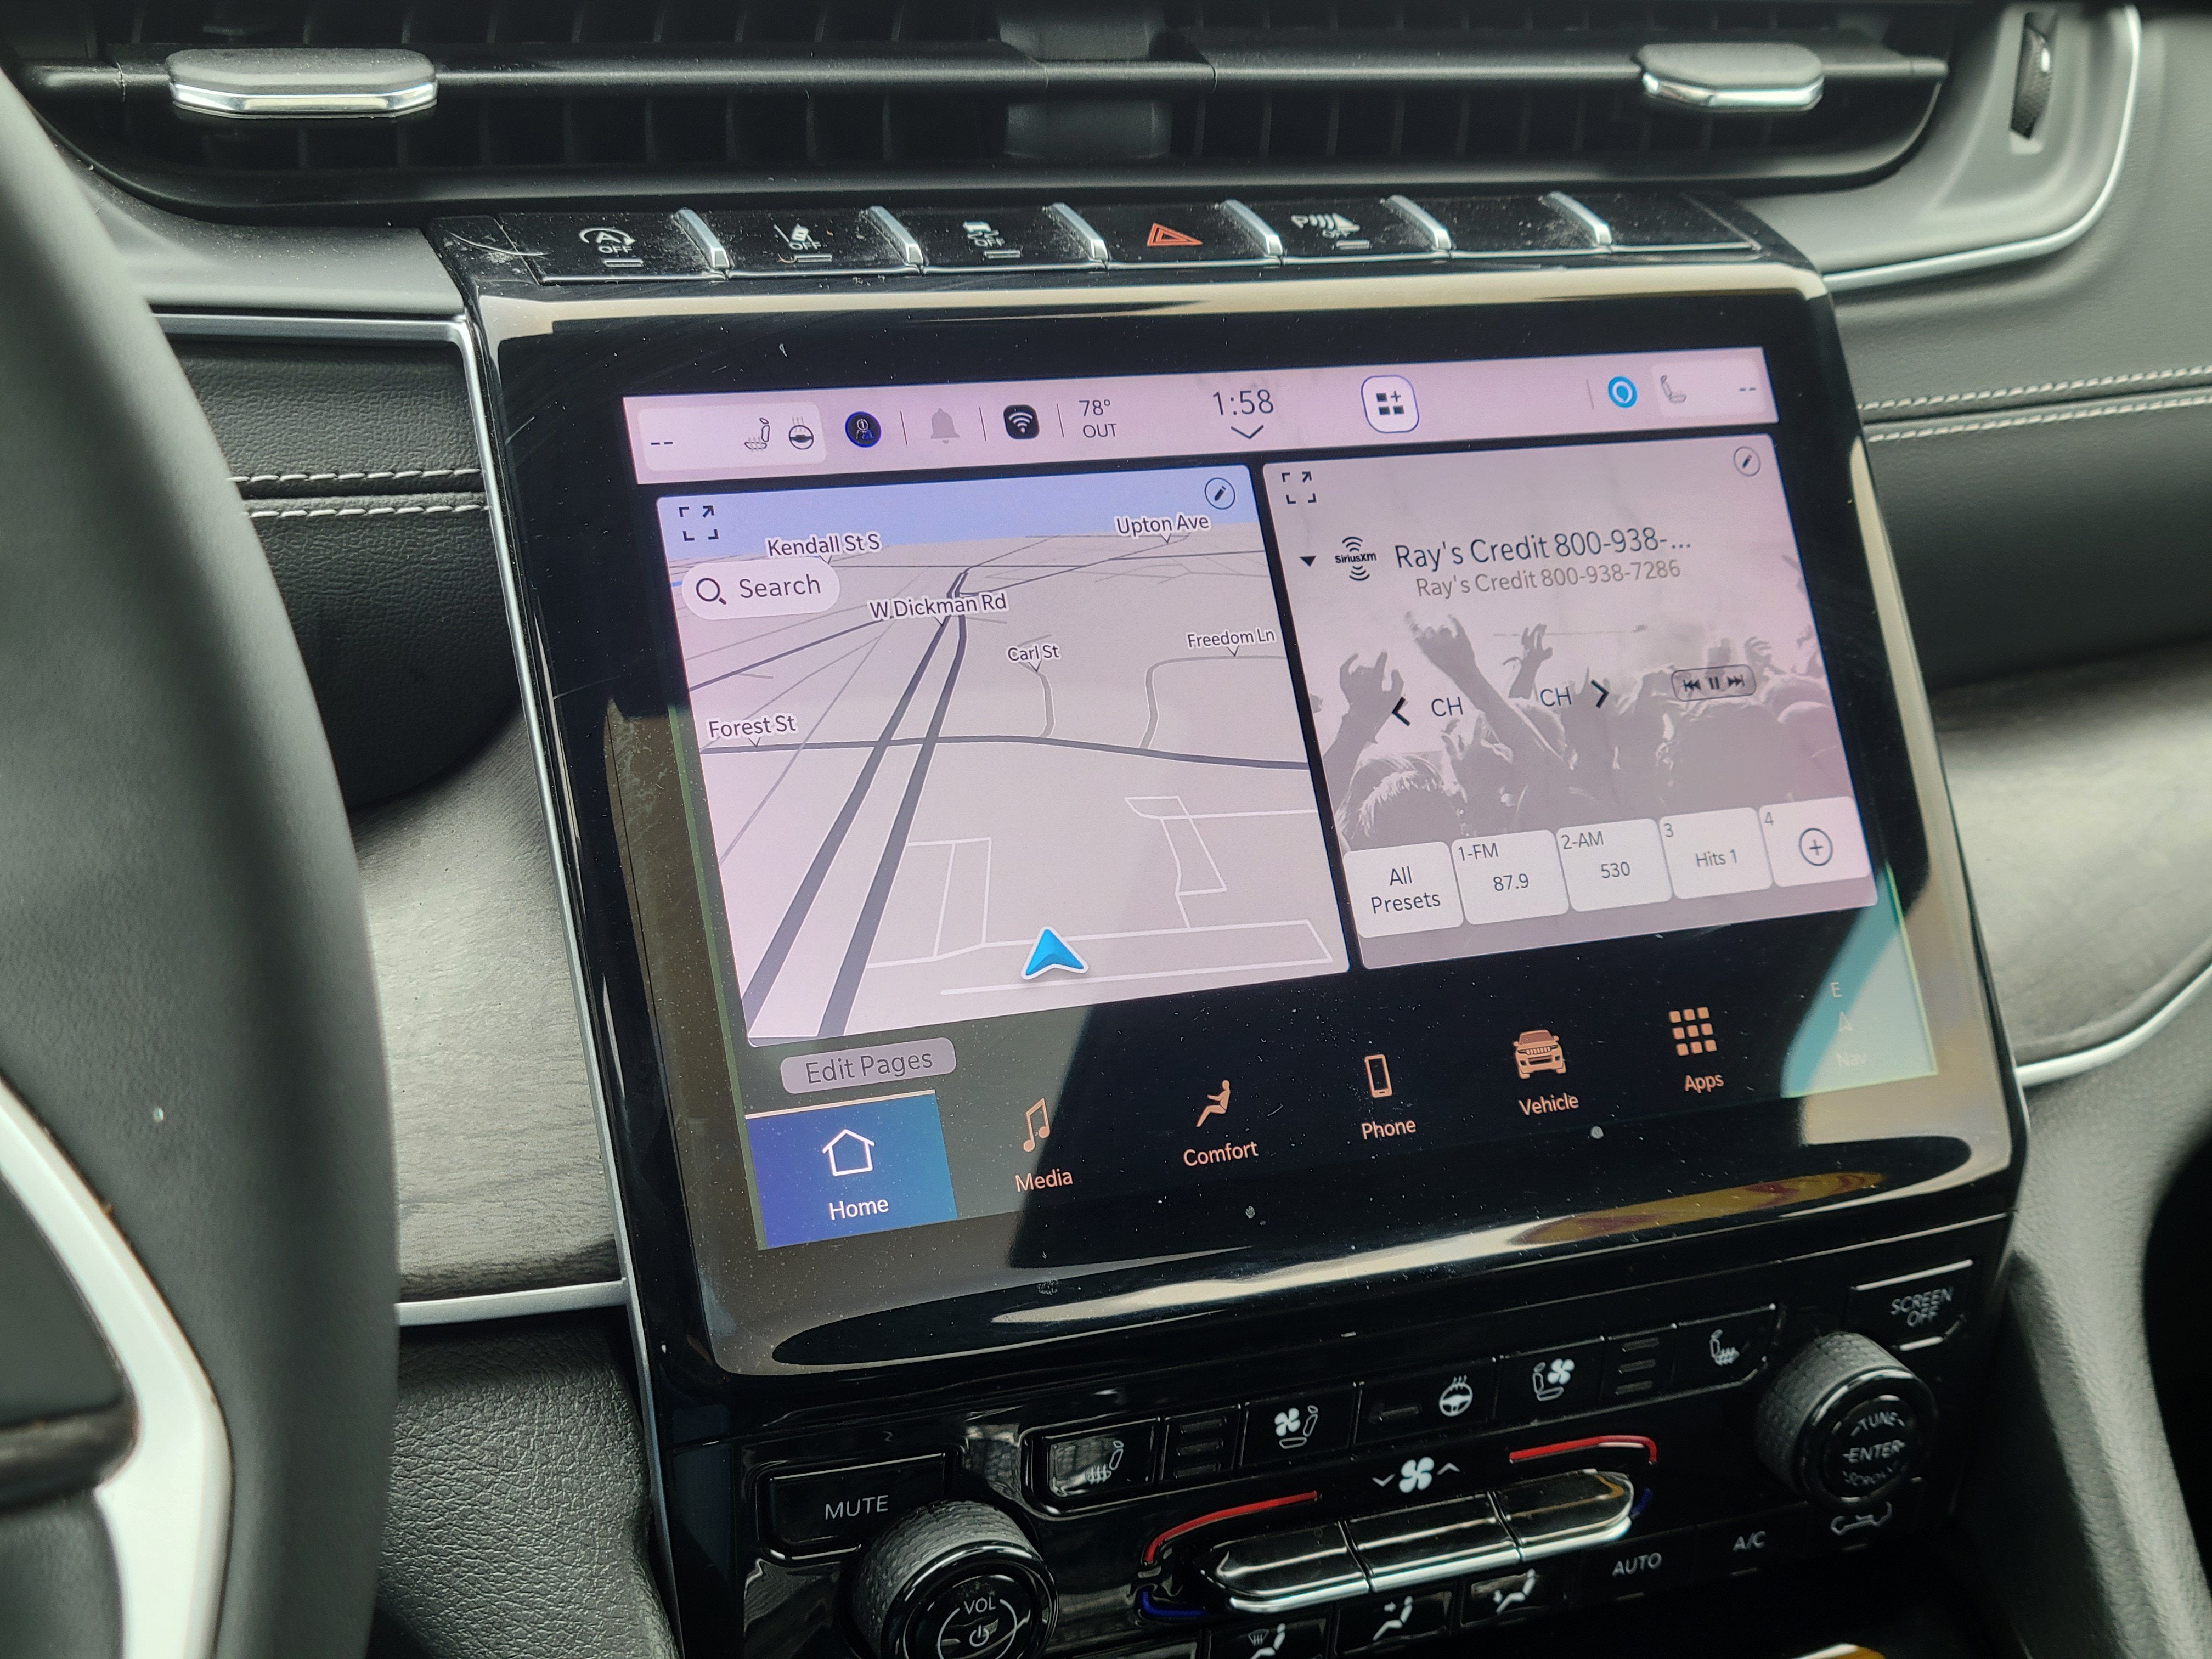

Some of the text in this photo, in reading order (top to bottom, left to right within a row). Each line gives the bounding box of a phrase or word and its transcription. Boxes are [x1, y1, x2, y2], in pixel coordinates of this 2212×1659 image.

[597, 245, 633, 253] OFF
[1079, 399, 1111, 416] 78°
[1212, 389, 1274, 416] 1:58
[1082, 423, 1117, 438] OUT
[1116, 514, 1210, 537] Upton Ave
[767, 533, 880, 556] Kendall St S
[1395, 541, 1464, 572] Ray's
[1470, 534, 1550, 563] Credit
[738, 573, 821, 599] Search
[1415, 558, 1681, 600] Ray's Credit 800-938-7286
[869, 592, 1007, 619] W Dickman Rd
[1187, 629, 1276, 647] Freedom Ln
[1007, 644, 1060, 662] Carl St
[1430, 696, 1464, 718] CH
[1539, 686, 1572, 707] CH
[708, 714, 797, 738] Forest St
[1764, 811, 1775, 826] 4
[1562, 831, 1605, 850] 2-AM
[1663, 823, 1674, 838] 3
[1458, 842, 1499, 862] 1-FM
[1695, 849, 1738, 868] Hits 1
[1389, 865, 1413, 887] All
[1600, 861, 1631, 879] 530
[1492, 873, 1530, 893] 87.9
[1371, 890, 1441, 915] Presets
[1830, 981, 1843, 998] E
[806, 1050, 934, 1085] Edit Pages
[1684, 1072, 1724, 1094] Apps
[1518, 1092, 1579, 1116] Vehicle
[1361, 1119, 1417, 1141] Phone
[1183, 1141, 1260, 1167] Comfort
[1014, 1168, 1074, 1193] Media
[828, 1198, 889, 1221] Home
[1890, 1288, 1953, 1316] SCREEN
[1906, 1307, 1938, 1327] OFF
[825, 1494, 889, 1520] MUTE
[1733, 1530, 1766, 1551] A/C
[1612, 1551, 1663, 1576] AUTO
[963, 1597, 997, 1615] VOL
